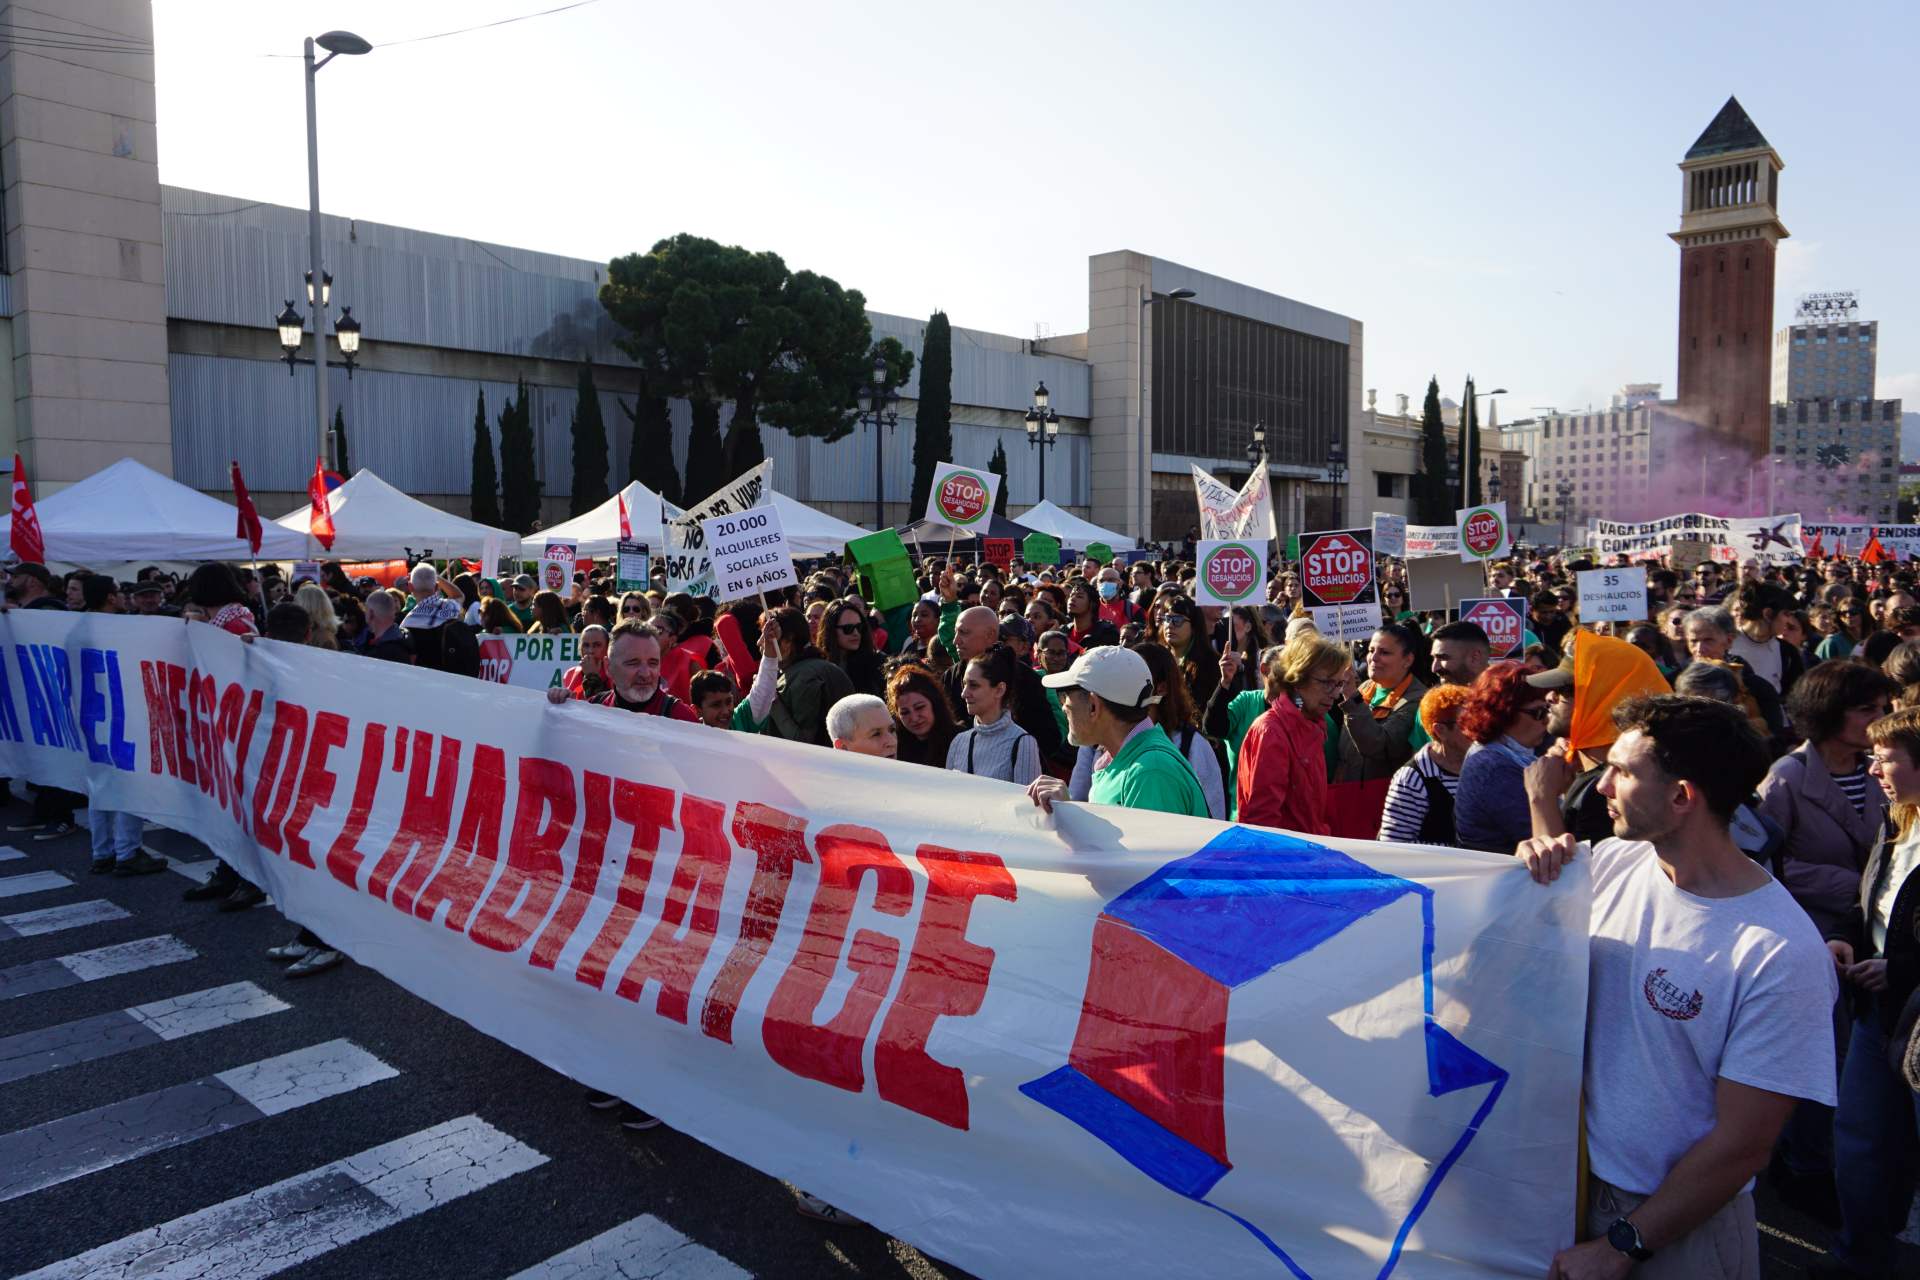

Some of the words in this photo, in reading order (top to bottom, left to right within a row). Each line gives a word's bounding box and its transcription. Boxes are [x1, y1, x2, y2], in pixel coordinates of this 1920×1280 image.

[945, 481, 983, 501] STOP
[943, 495, 981, 510] DESAHUCIOS
[716, 514, 767, 537] 20.000
[1468, 519, 1497, 536] STOP
[1599, 521, 1636, 536] VAGA
[1660, 514, 1730, 531] LLOGUERS
[714, 532, 782, 558] ALQUILERES
[986, 543, 1011, 557] STOP
[1602, 536, 1659, 553] CONTRA
[547, 552, 573, 561] STOP
[726, 552, 779, 574] SOCIALES
[1308, 550, 1366, 576] STOP
[1211, 557, 1252, 574] STOP
[727, 580, 744, 592] EN
[745, 577, 753, 588] 6
[755, 568, 788, 585] AÑOS
[1211, 573, 1252, 582] DESAHUCIOS
[1310, 573, 1366, 587] DESAHUCIOS
[1603, 575, 1620, 587] 35
[1583, 590, 1642, 602] DESHAUCIOS
[1597, 604, 1609, 613] AL
[1335, 624, 1376, 635] POTECCION
[1340, 616, 1369, 626] AMILIAS
[514, 637, 555, 661] POR
[479, 658, 510, 684] TOP
[80, 647, 136, 773] EL
[140, 660, 264, 837] NEGOCI
[252, 700, 350, 870] DE
[326, 721, 1019, 1131] L'HABITATGE
